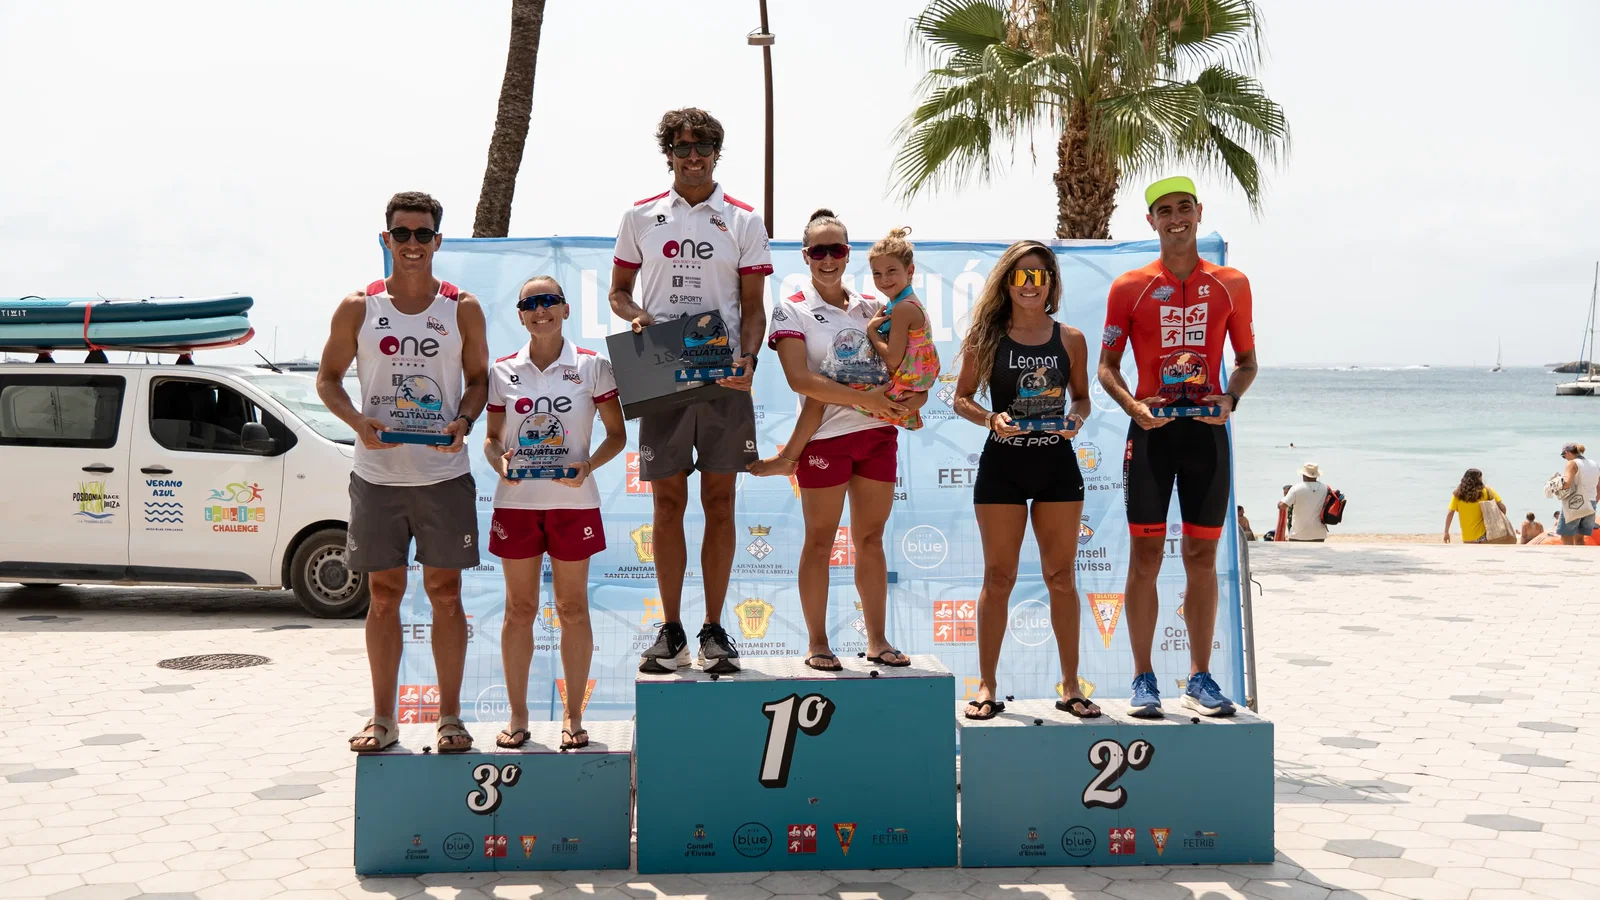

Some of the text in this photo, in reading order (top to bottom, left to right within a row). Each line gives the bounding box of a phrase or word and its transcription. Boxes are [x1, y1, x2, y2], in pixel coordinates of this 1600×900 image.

[663, 239, 714, 260] one
[679, 294, 703, 303] SPORTY
[1186, 331, 1204, 344] TD
[379, 336, 440, 357] one
[1009, 350, 1058, 369] Leonor
[515, 396, 572, 414] one
[990, 431, 1059, 448] NIKE PRO
[146, 480, 183, 488] VERANO
[1088, 483, 1098, 491] de
[152, 489, 176, 497] AZUL
[212, 524, 259, 533] CHALLENGE
[907, 540, 942, 557] blue
[1014, 616, 1049, 631] blue
[957, 627, 975, 637] TD
[737, 833, 768, 847] blue
[872, 833, 909, 843] FETRIB
[1065, 837, 1092, 849] blue
[1183, 838, 1215, 848] FETRIB
[446, 843, 470, 852] blue
[551, 843, 578, 852] FETRIB
[686, 842, 713, 850] Consell
[684, 849, 716, 858] d'Eivissa
[1018, 849, 1047, 857] d'Eivissa
